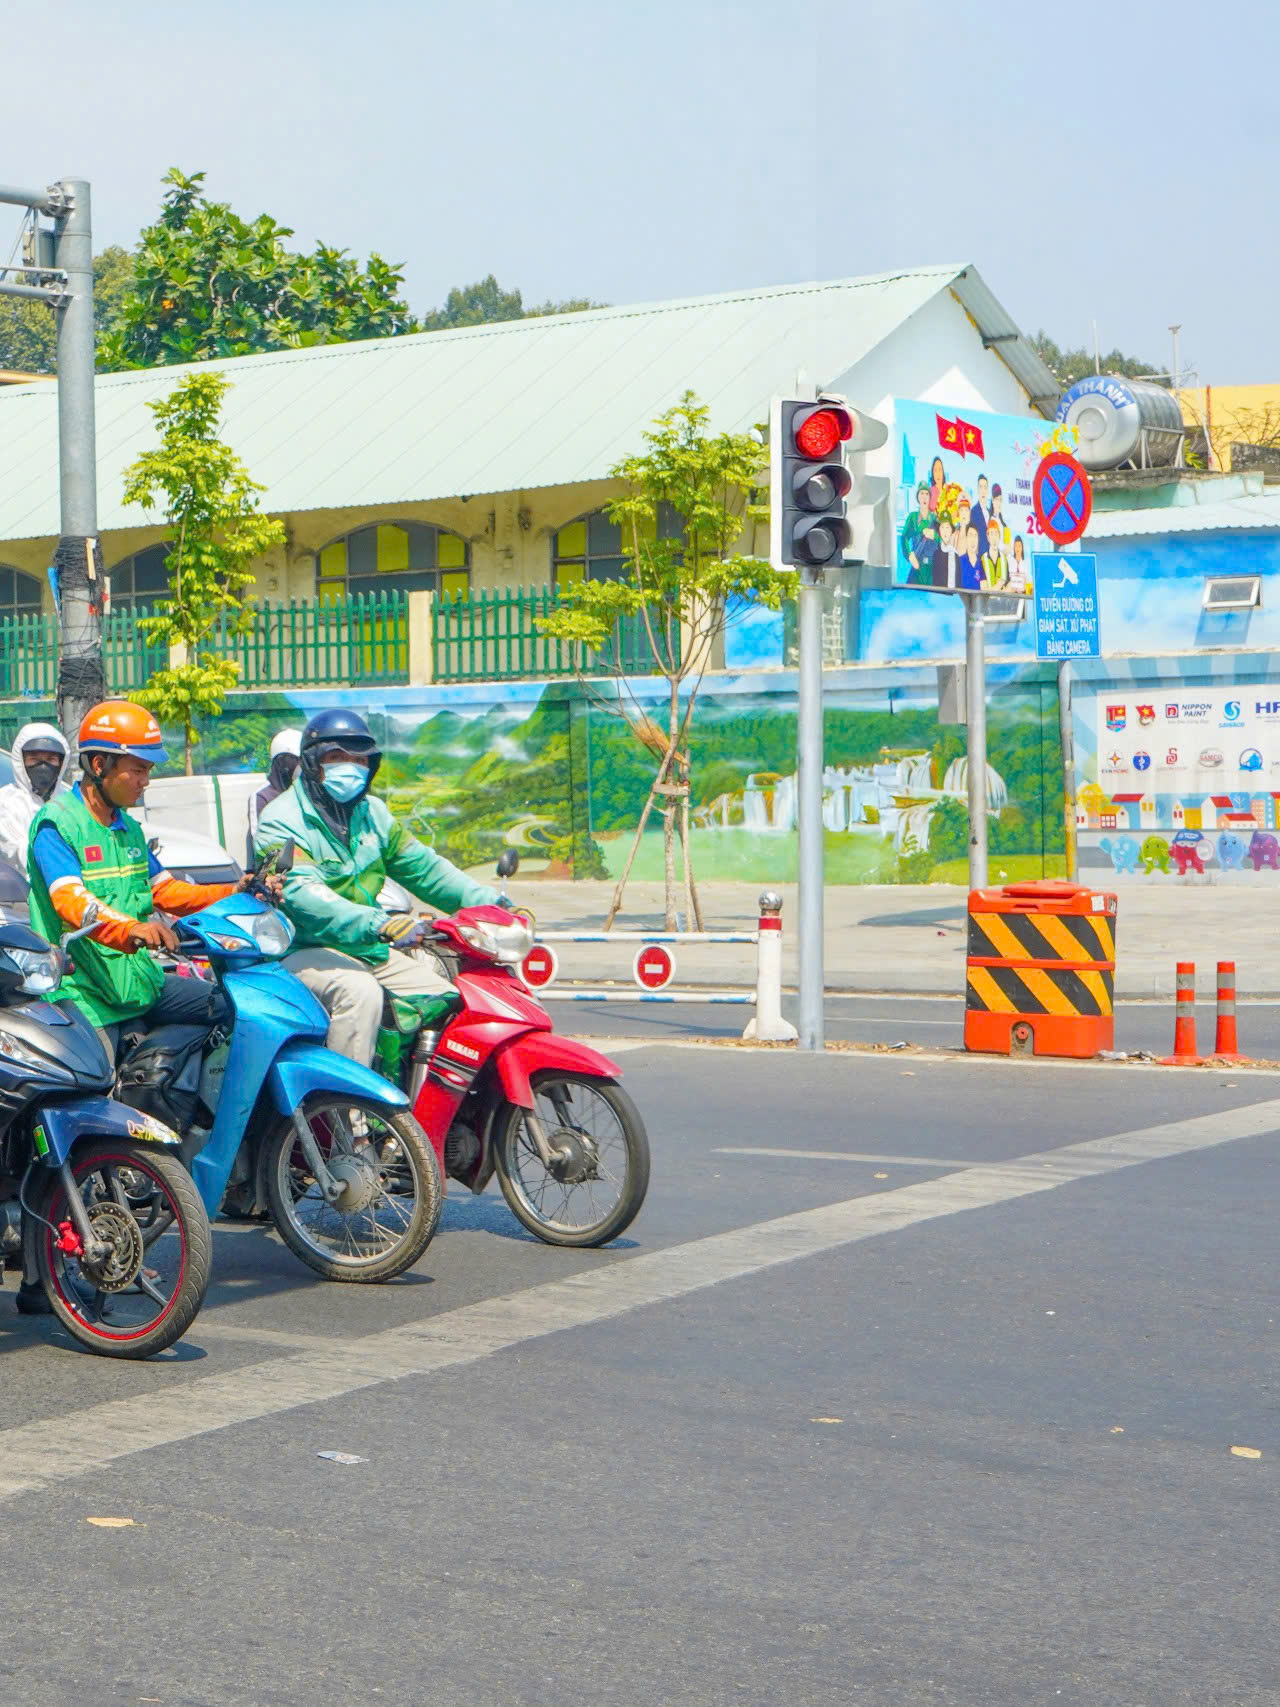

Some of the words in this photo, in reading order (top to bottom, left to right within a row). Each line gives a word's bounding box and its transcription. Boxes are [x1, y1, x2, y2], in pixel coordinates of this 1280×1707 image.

[1065, 640, 1092, 655] CAMERA
[1181, 703, 1213, 711] NIPPON
[447, 1039, 480, 1061] YAMAHA
